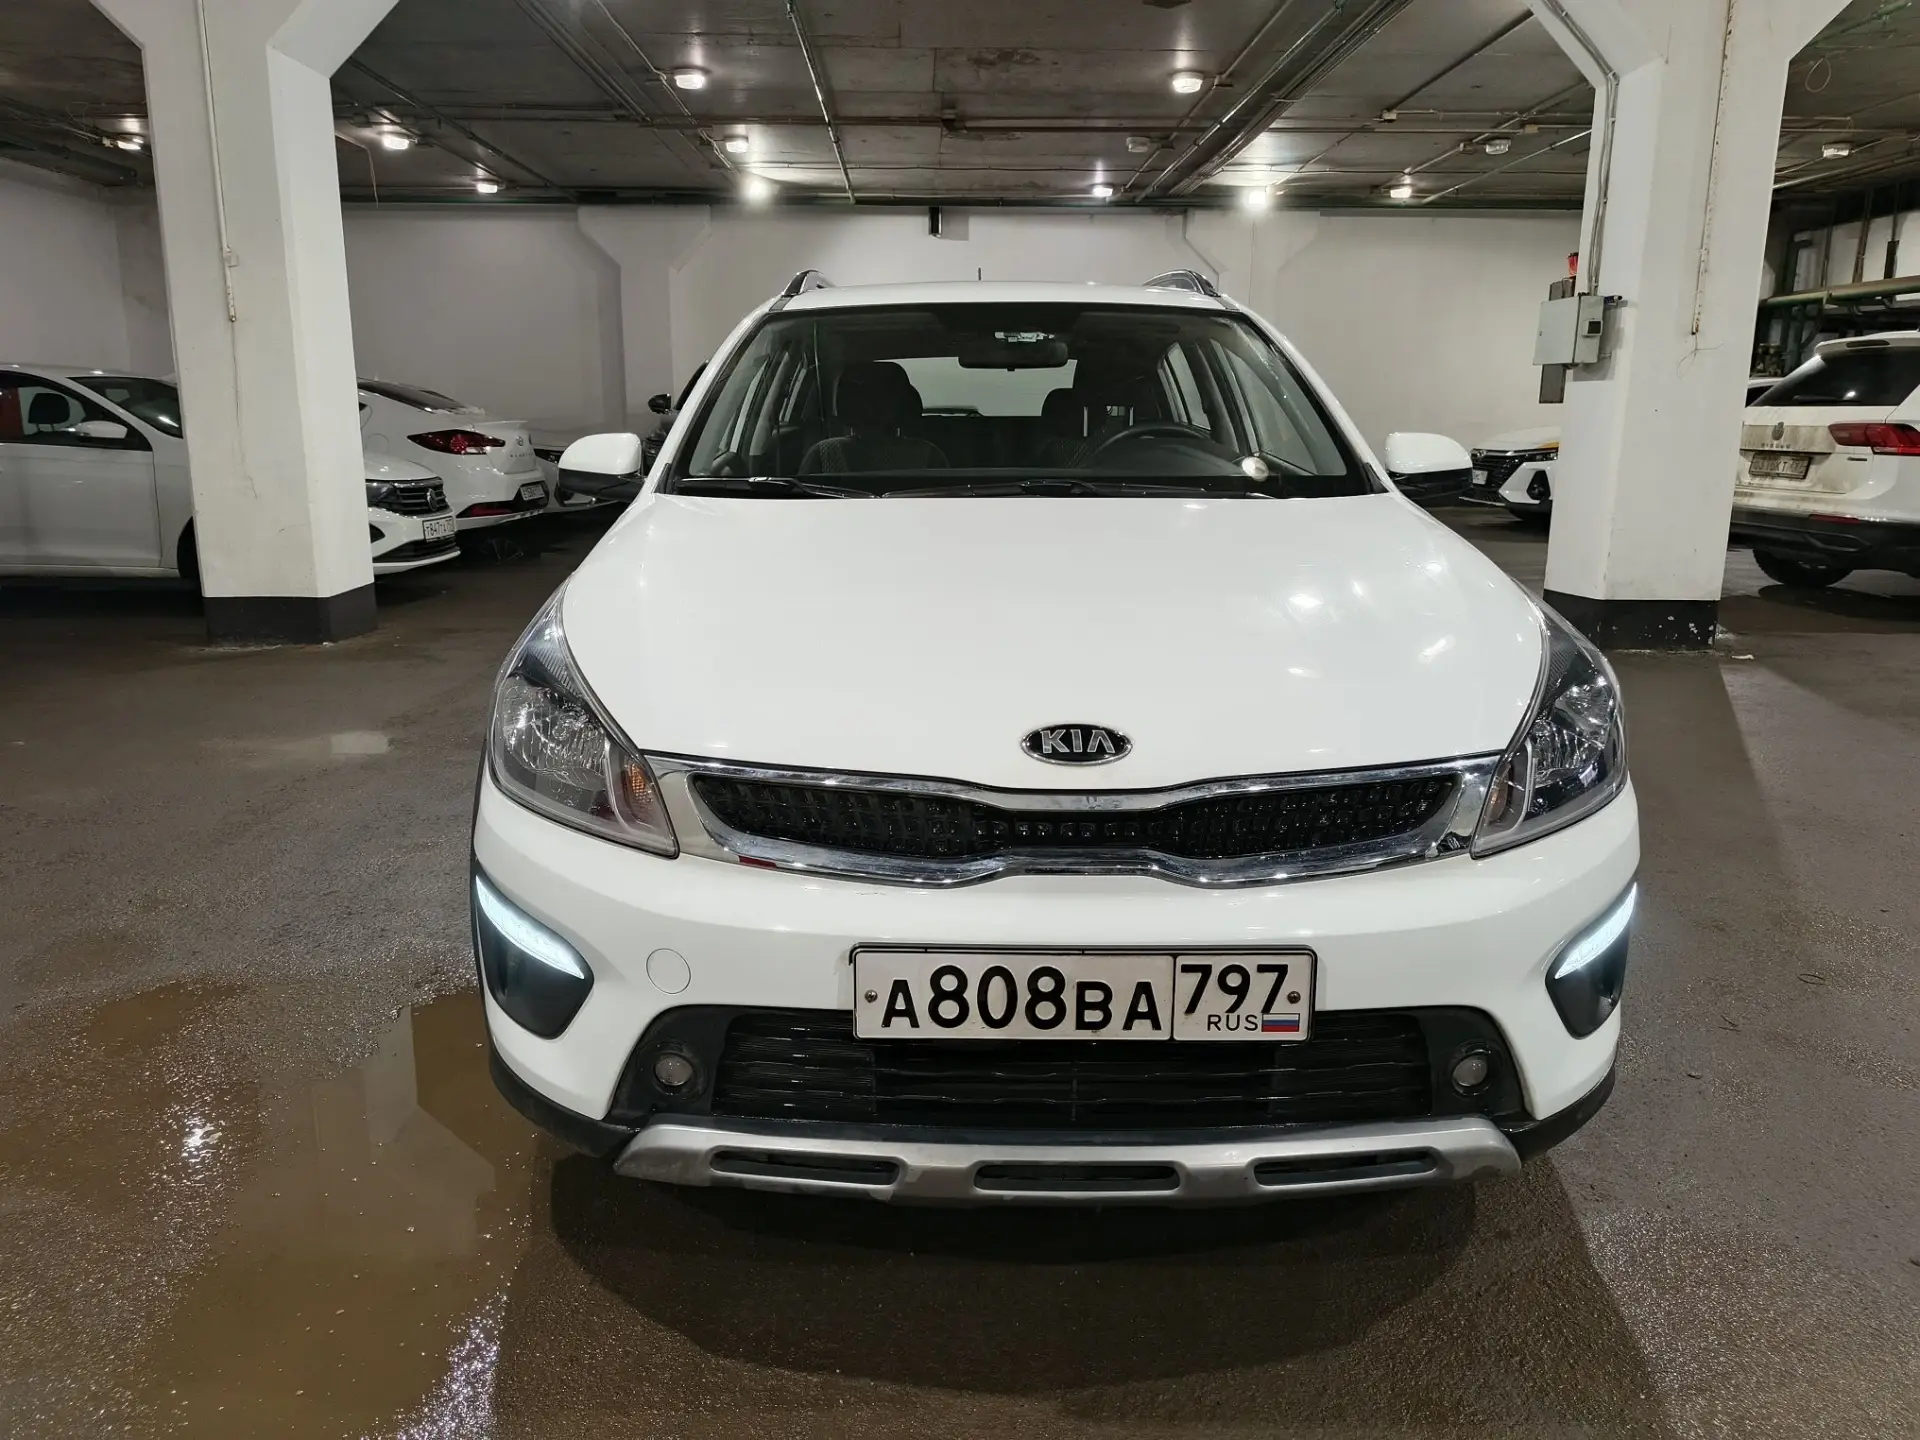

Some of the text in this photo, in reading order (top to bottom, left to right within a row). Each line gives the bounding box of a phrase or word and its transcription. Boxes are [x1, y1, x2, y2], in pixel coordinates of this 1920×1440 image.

[1040, 729, 1116, 754] KIA
[882, 963, 1288, 1031] А808ВА 797
[1207, 1014, 1258, 1032] RUS
